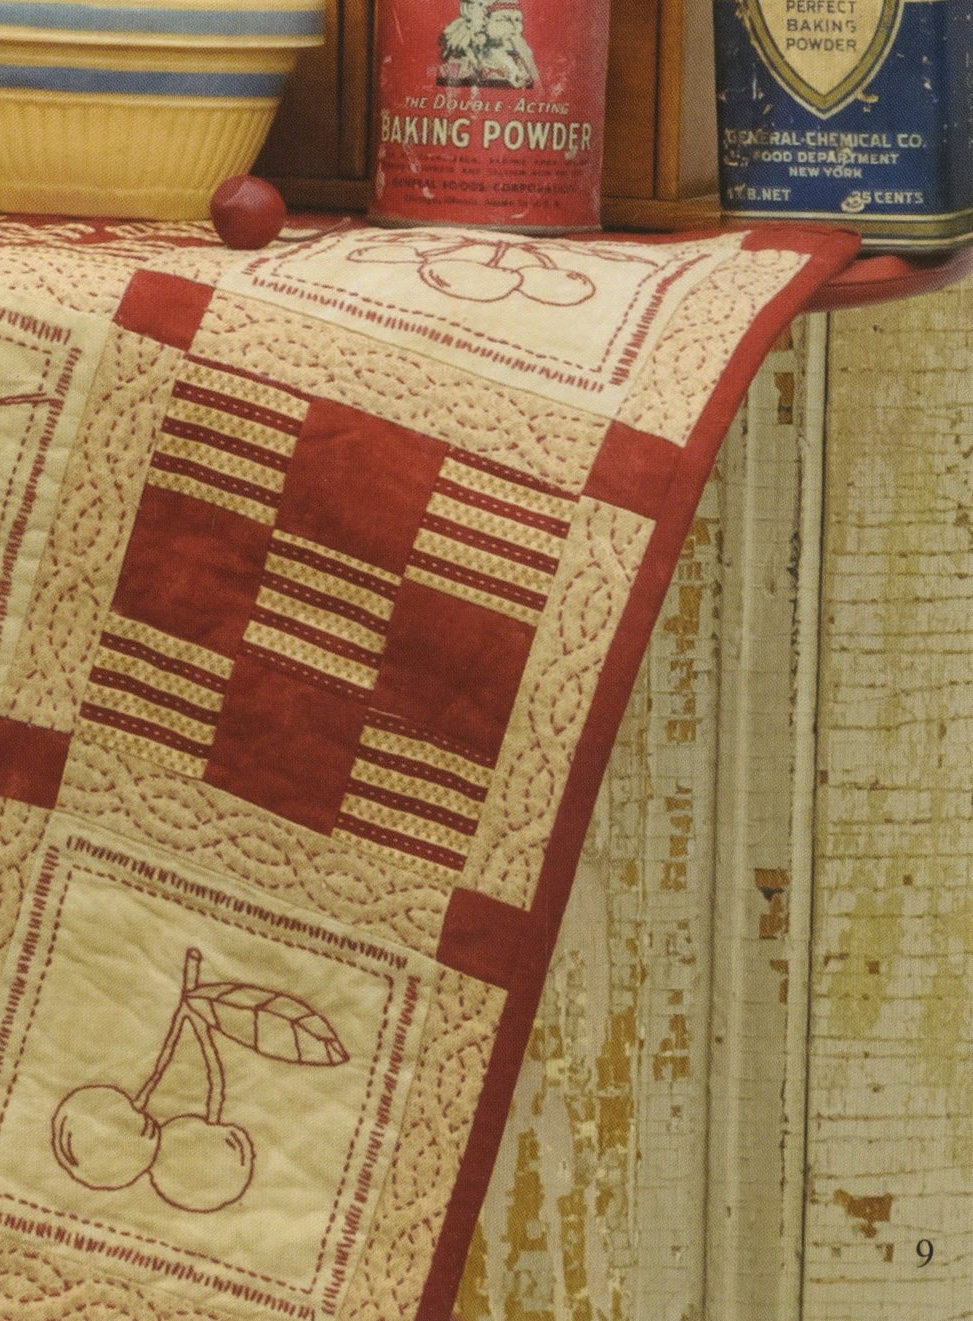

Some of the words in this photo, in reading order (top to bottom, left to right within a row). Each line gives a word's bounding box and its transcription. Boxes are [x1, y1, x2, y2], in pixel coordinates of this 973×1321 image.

[786, 0, 856, 14] PERFECT
[787, 19, 857, 33] BAKING
[786, 38, 857, 51] POWDER
[404, 96, 427, 108] THE
[381, 116, 470, 147] BAKING
[483, 120, 591, 151] POWDER
[896, 133, 926, 148] CO.
[798, 151, 899, 165] DEPARTMENT
[789, 166, 819, 177] NEW
[824, 166, 863, 178] YORK
[874, 191, 924, 204] CENTS
